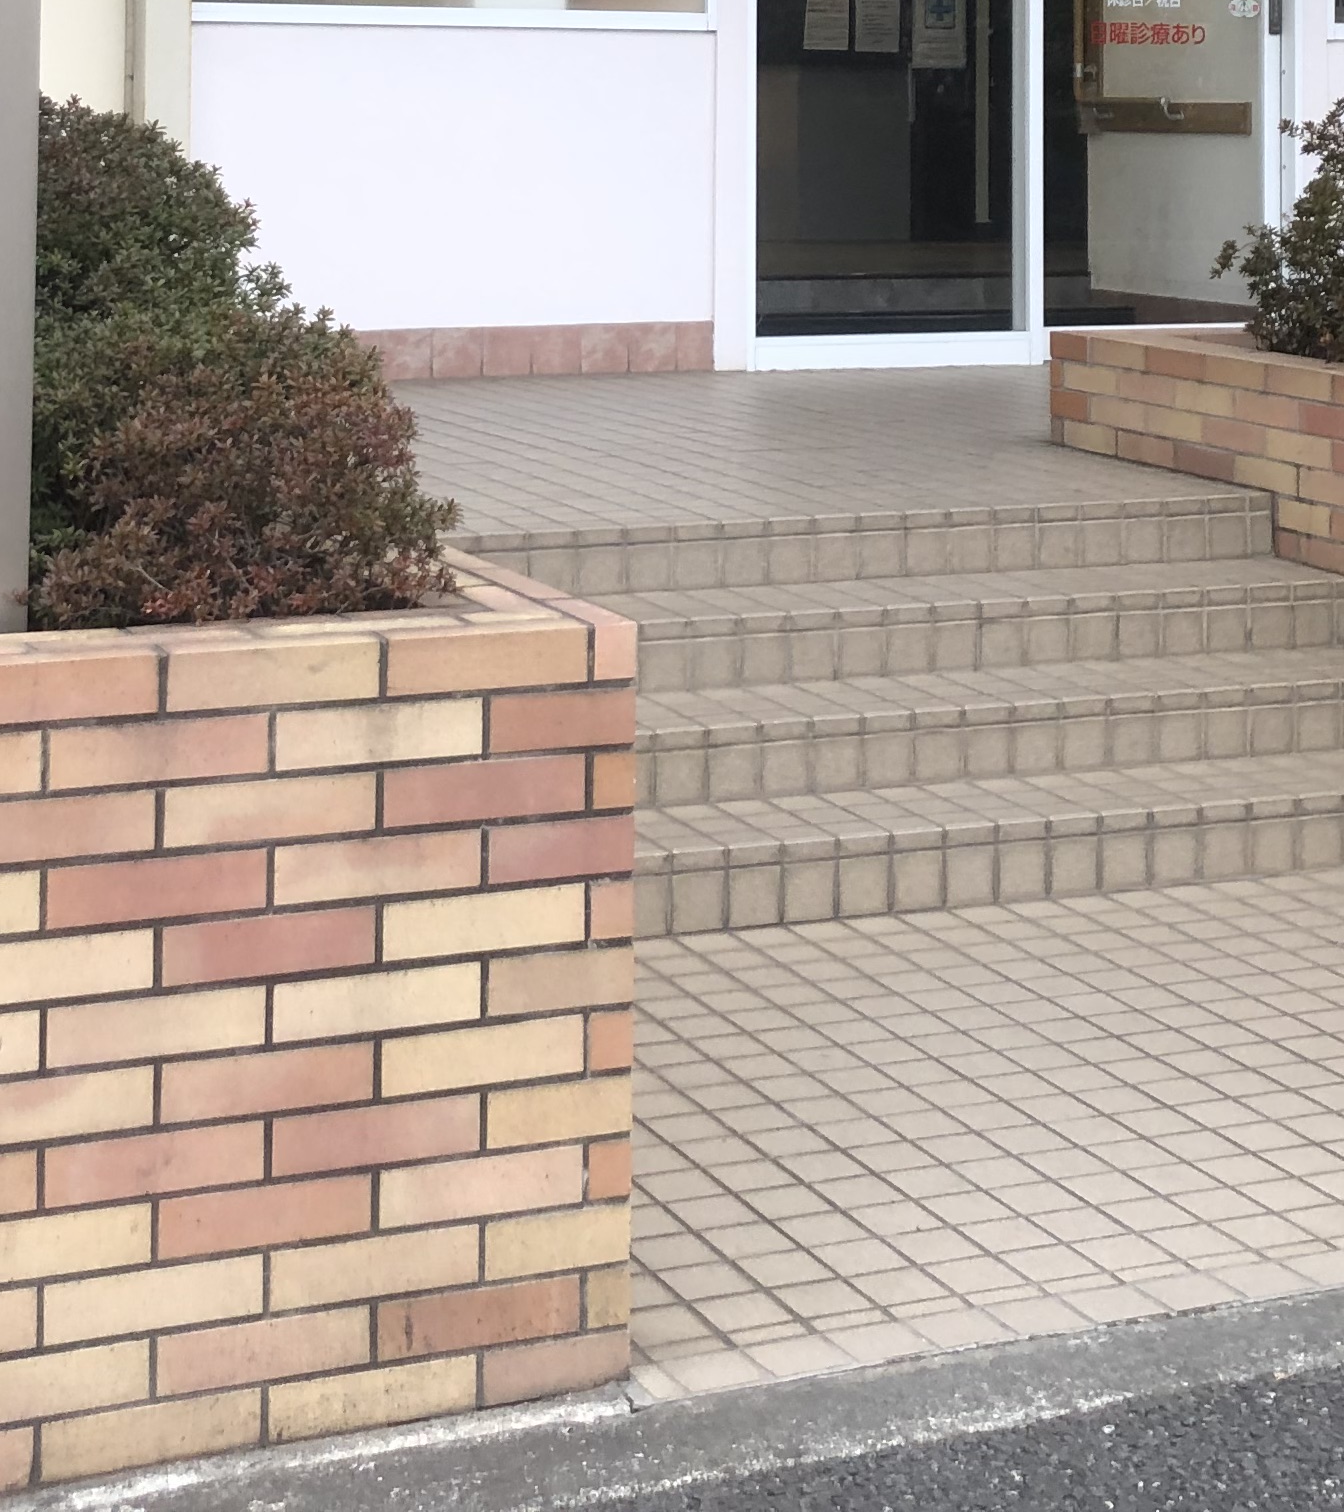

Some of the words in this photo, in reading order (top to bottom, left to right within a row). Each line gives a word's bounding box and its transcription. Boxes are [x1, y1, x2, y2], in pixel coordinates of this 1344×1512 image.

[1090, 20, 1206, 46] 日曜診療あり
